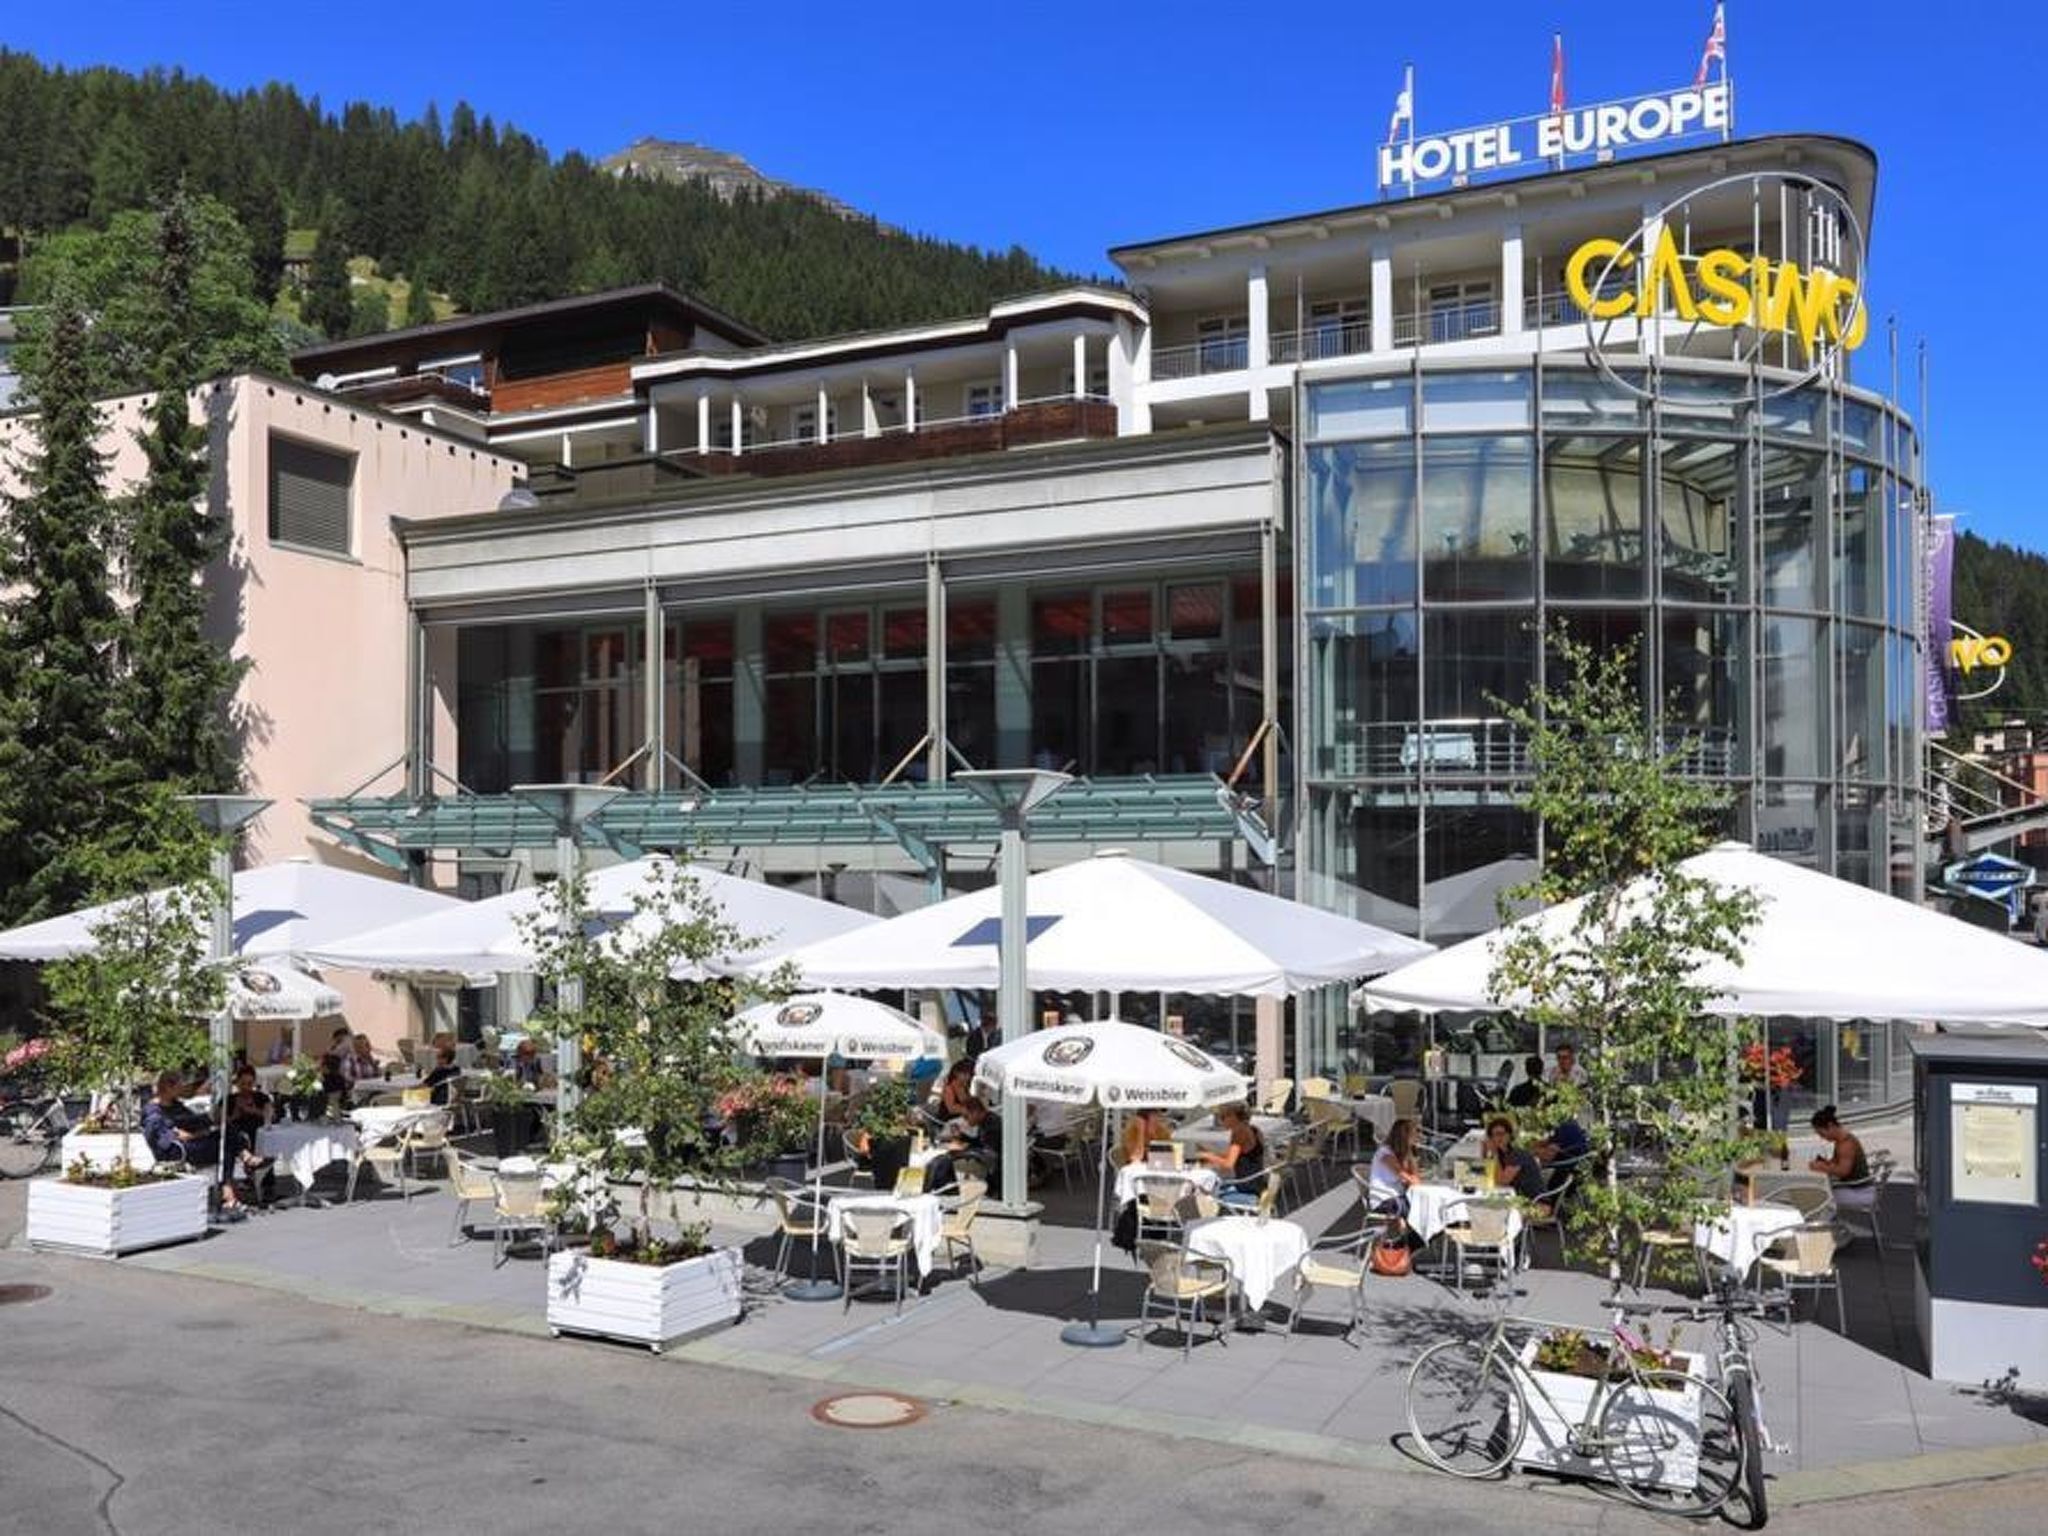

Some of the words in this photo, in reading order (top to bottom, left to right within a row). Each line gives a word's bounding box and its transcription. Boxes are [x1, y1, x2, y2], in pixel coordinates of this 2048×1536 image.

[1381, 125, 1522, 186] HOTEL
[1537, 84, 1728, 158] EUROPE
[1565, 223, 1868, 359] CASINO
[1125, 1087, 1188, 1102] Weissbier
